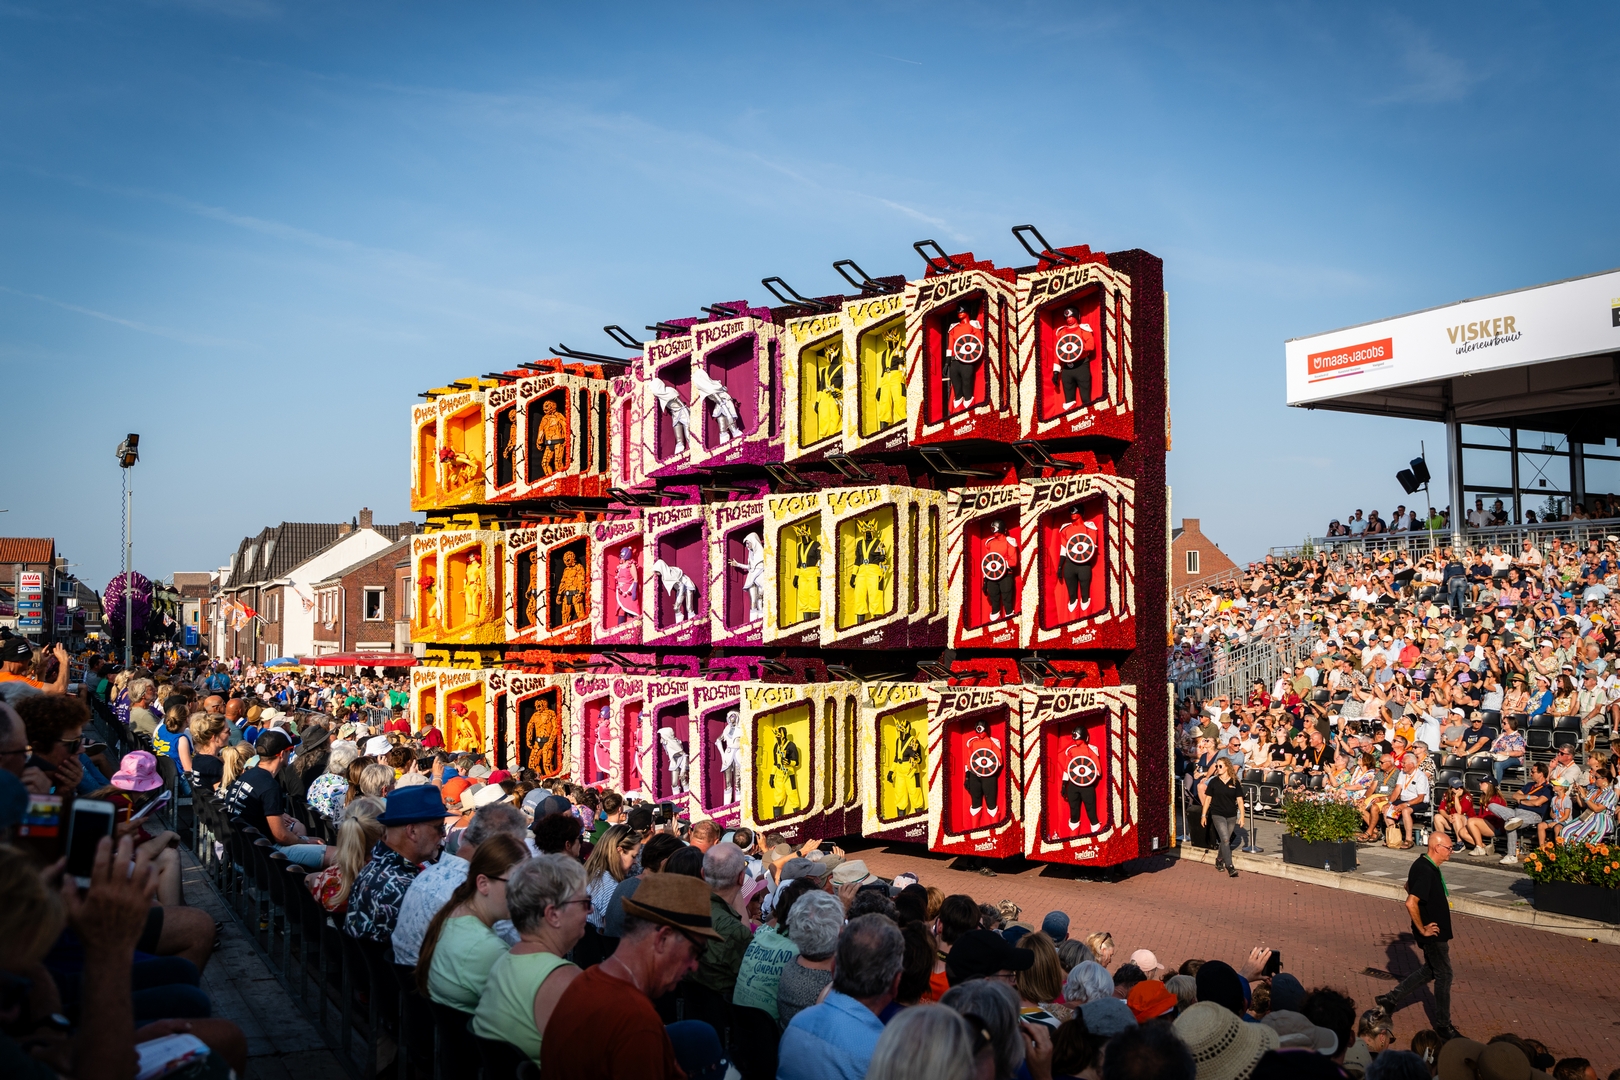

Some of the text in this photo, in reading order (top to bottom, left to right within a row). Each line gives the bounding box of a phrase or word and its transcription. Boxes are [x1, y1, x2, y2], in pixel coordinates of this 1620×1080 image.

[914, 274, 972, 312] FOCUS
[1026, 268, 1089, 306] FOCUS
[696, 321, 744, 351] FROSTBITE
[1446, 316, 1517, 344] VISKER
[1455, 331, 1523, 355] interieurbouw
[1071, 419, 1092, 433] helden
[955, 489, 1013, 518] FOCUS
[1028, 478, 1091, 512] FOCUS
[648, 507, 692, 533] FROSTBITE
[716, 503, 763, 530] FROSTBITE
[935, 691, 994, 717] FOCUS
[1031, 692, 1095, 719] FOCUS
[1074, 850, 1095, 860] helden
[750, 945, 775, 963] PETROL
